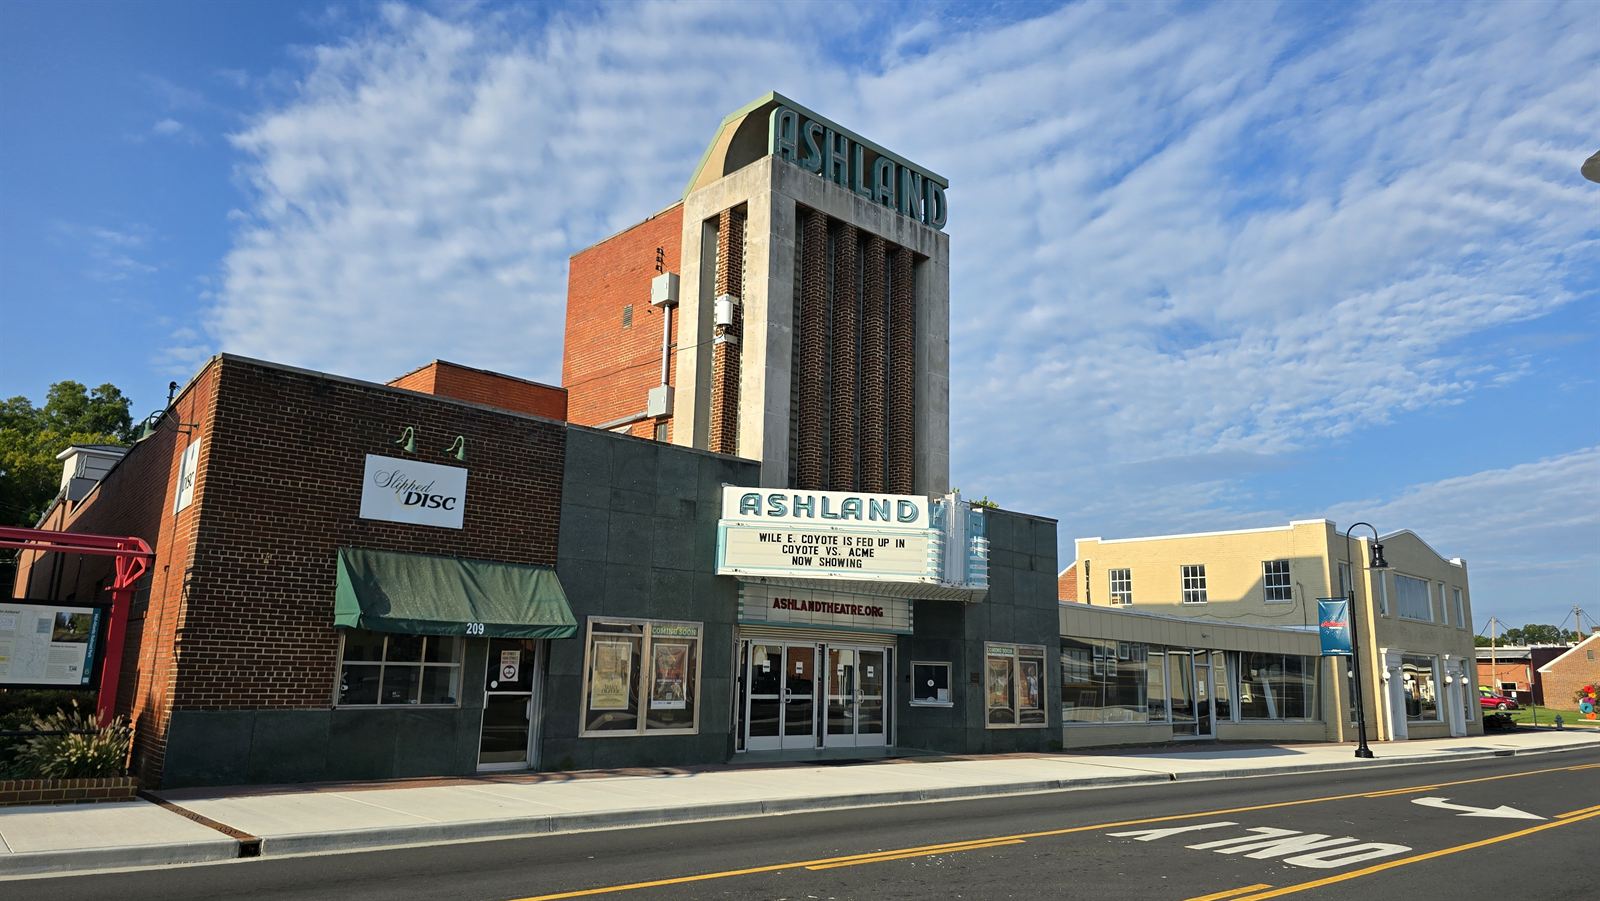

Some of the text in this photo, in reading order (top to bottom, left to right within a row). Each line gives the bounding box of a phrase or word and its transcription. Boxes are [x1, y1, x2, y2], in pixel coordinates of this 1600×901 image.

[768, 105, 948, 230] ASHLAND
[373, 469, 435, 494] Slipped
[404, 491, 457, 511] DISC
[739, 492, 919, 523] ASHLAND
[759, 532, 905, 548] WILE E. COYOTE IS FED UP IN
[782, 544, 875, 558] COYOTE VS. ACME
[792, 556, 862, 569] NOW SHOWING
[772, 597, 883, 618] ASHLANDTHEATRE.ORG
[466, 622, 485, 635] 209
[652, 627, 697, 636] COMING SOON
[1105, 821, 1413, 868] ONLY
